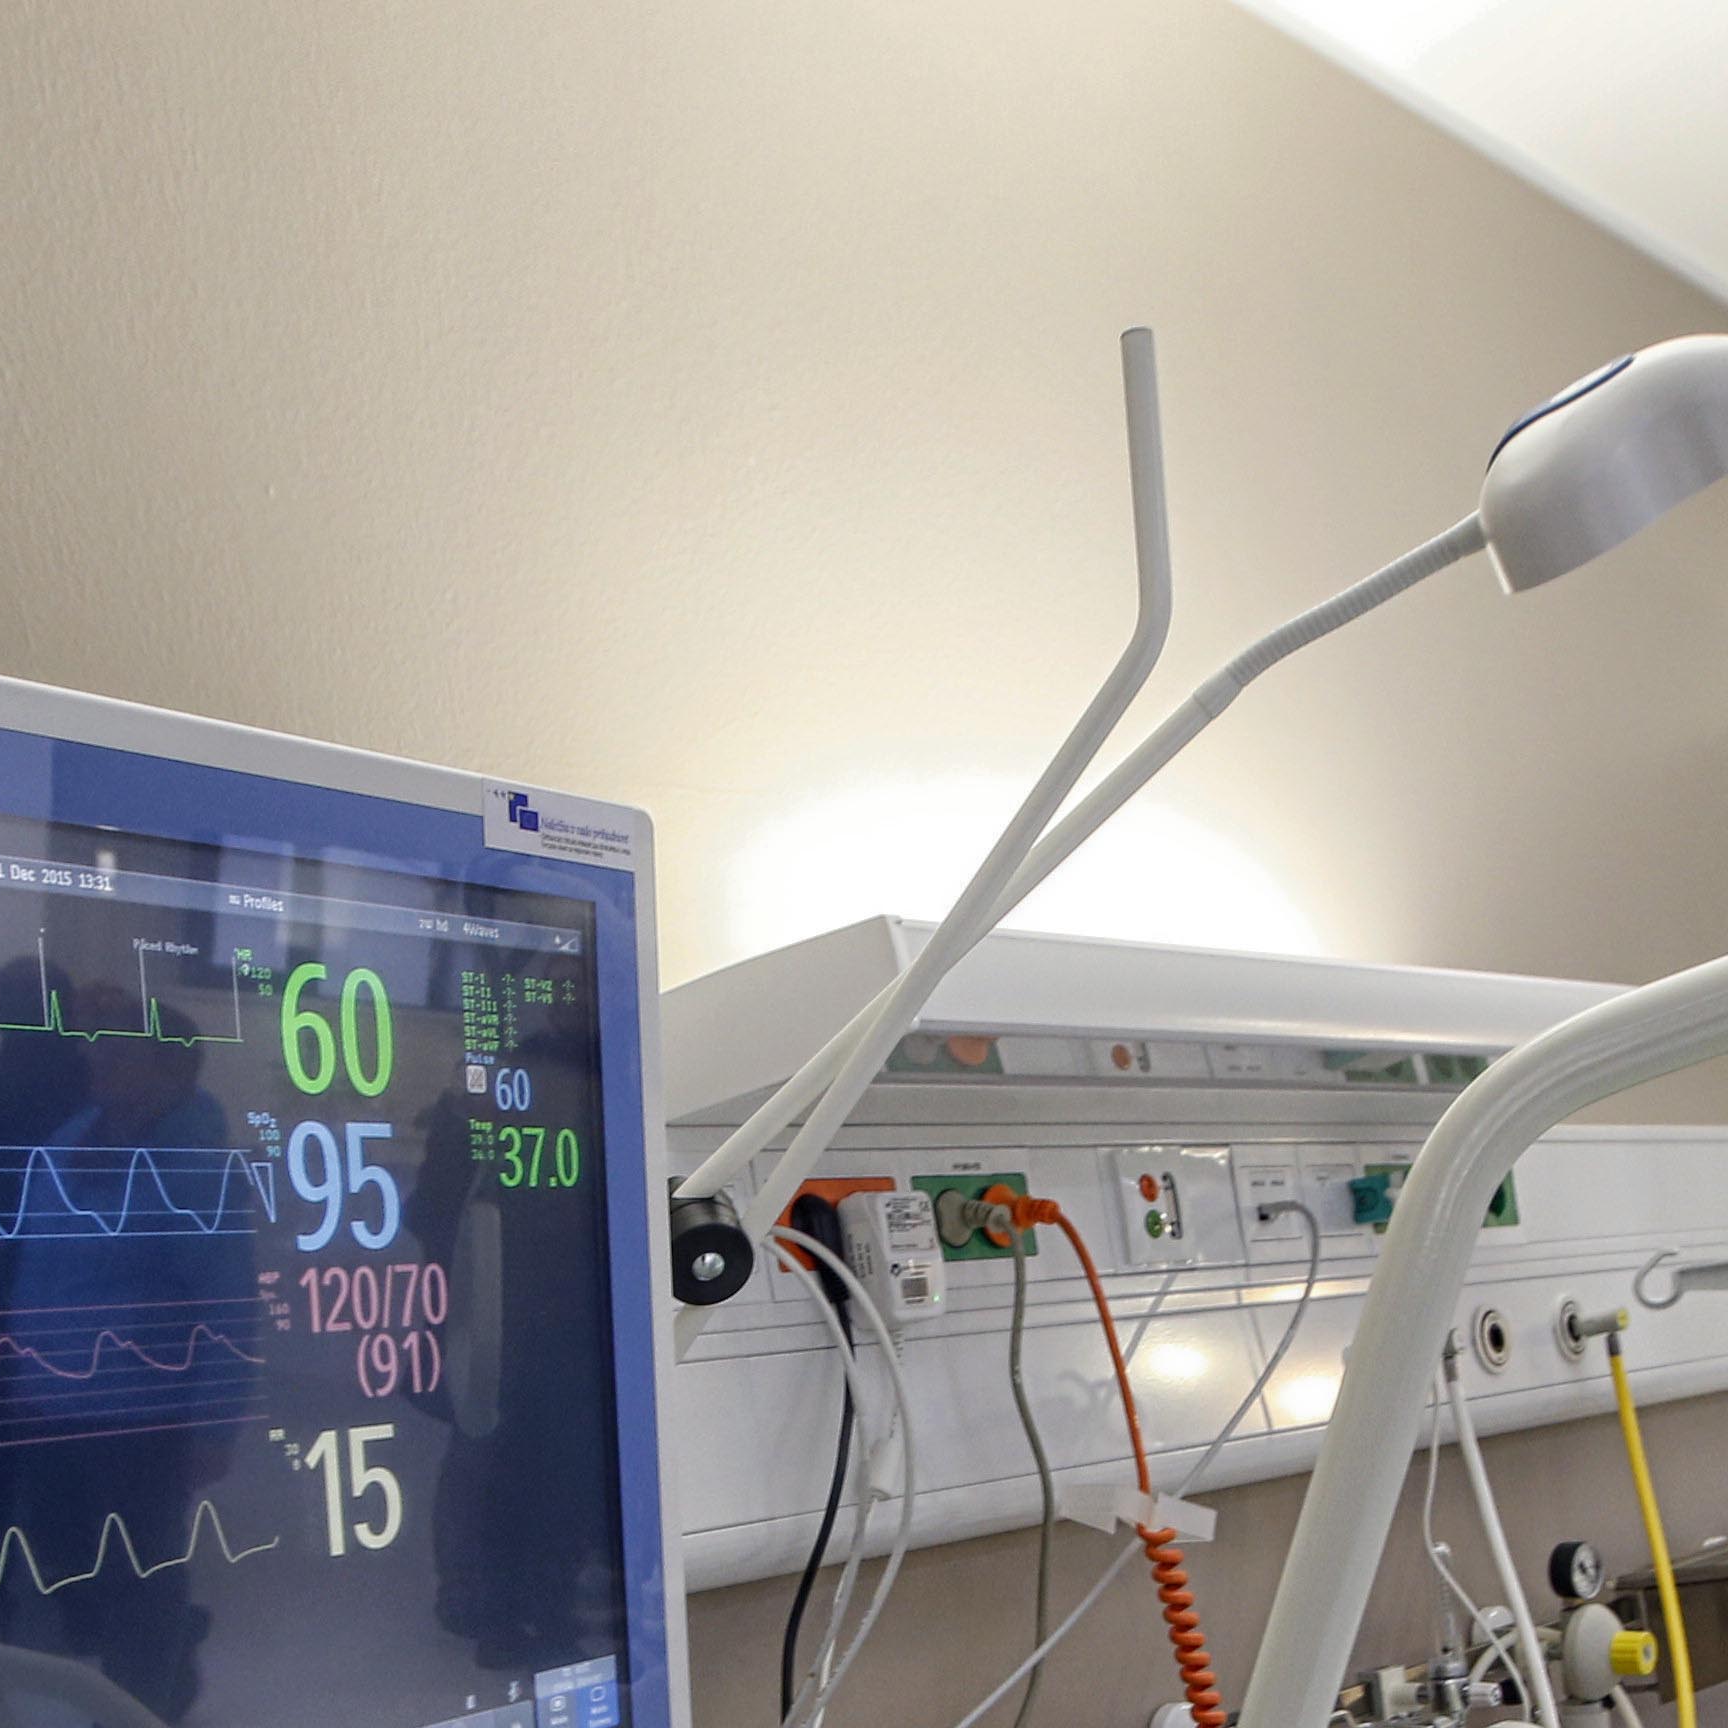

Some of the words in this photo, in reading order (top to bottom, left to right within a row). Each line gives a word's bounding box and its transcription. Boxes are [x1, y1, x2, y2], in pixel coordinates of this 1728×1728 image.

[10, 863, 36, 882] Dec
[41, 868, 73, 886] 2015
[78, 873, 114, 892] 13:31
[243, 894, 284, 912] Profiles
[251, 967, 271, 980] 120
[258, 984, 272, 996] 50
[281, 962, 393, 1097] 60
[464, 1052, 495, 1065] Pulse
[495, 1067, 531, 1112] 60
[259, 1129, 282, 1142] 100
[468, 1119, 494, 1133] Temp
[266, 1145, 281, 1157] 90
[498, 1126, 580, 1187] 37.0
[287, 1120, 400, 1251] 95
[298, 1262, 448, 1333] 120/70
[356, 1330, 441, 1398] (91)
[303, 1422, 403, 1557] 15
